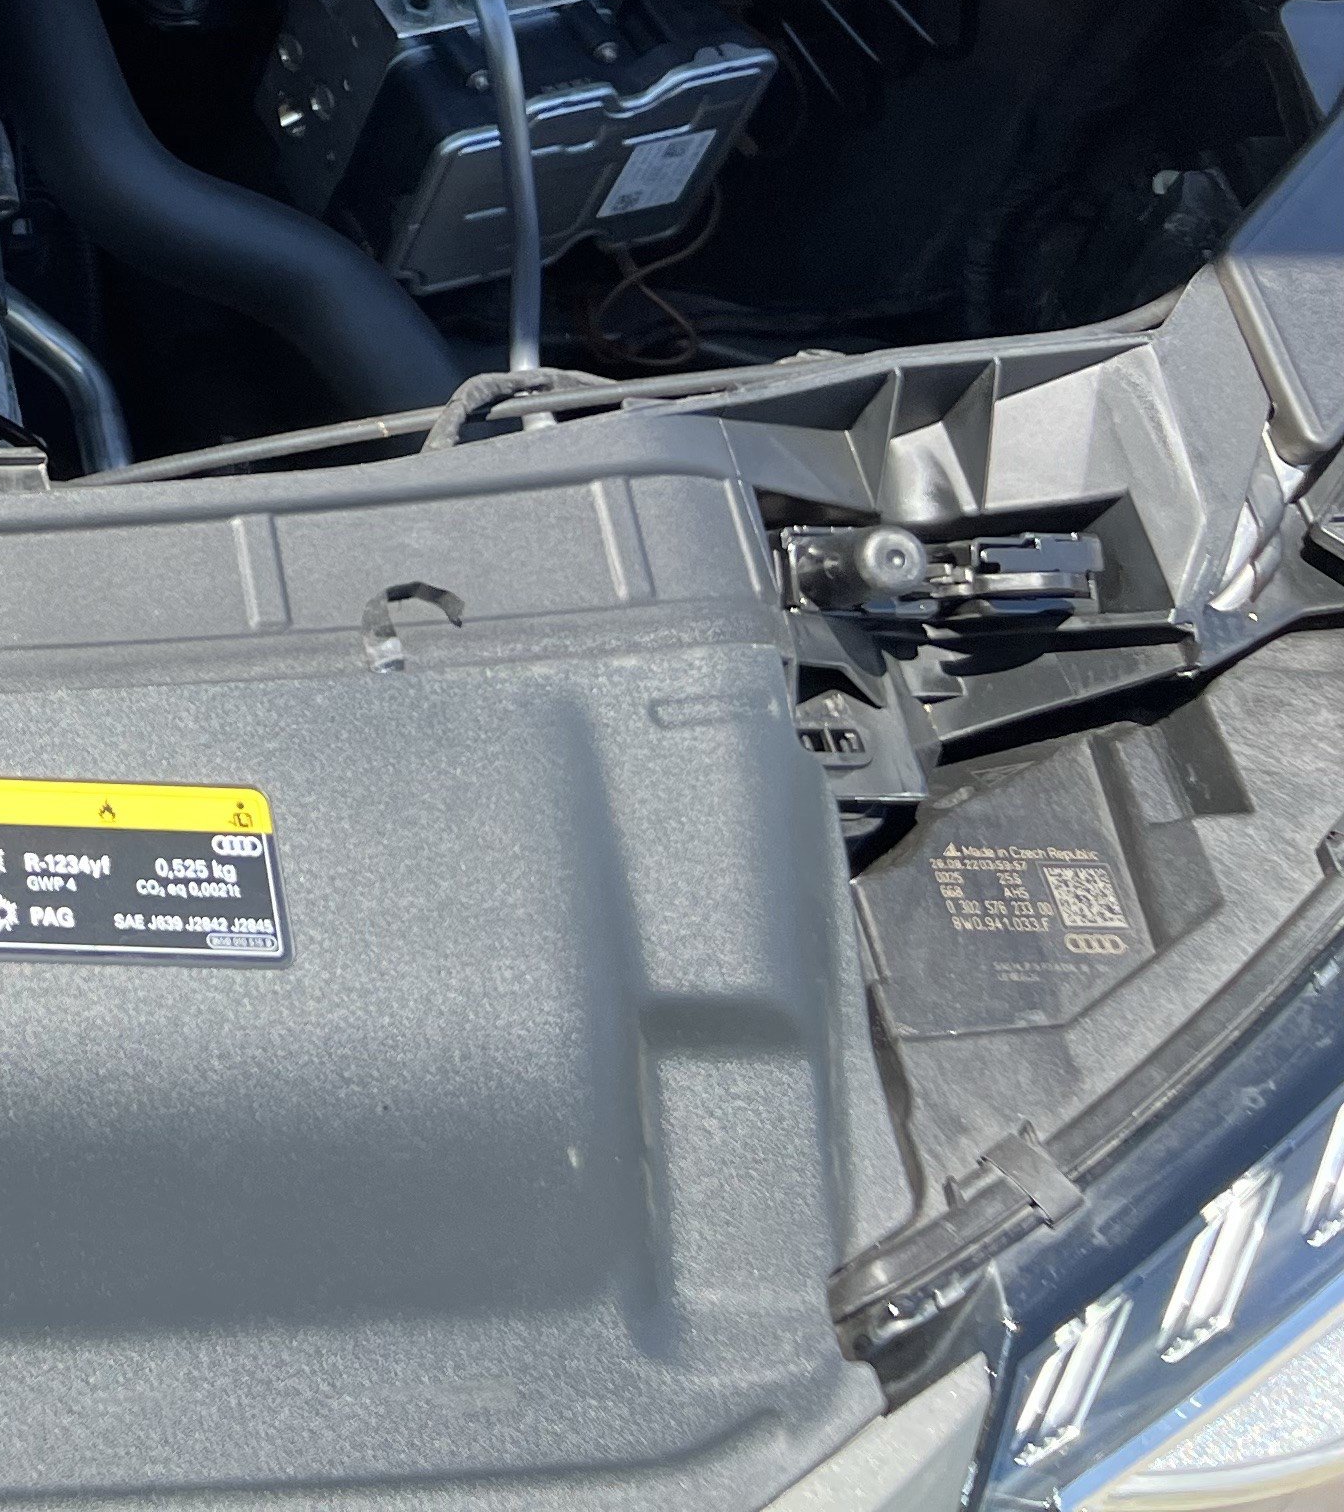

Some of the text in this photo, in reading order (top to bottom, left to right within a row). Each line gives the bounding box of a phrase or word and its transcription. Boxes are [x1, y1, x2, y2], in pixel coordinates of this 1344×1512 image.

[962, 844, 1099, 863] Made in Czech Republic
[23, 852, 111, 879] R-1234yf
[211, 860, 238, 883] kg
[27, 875, 65, 892] GWP
[29, 906, 75, 928] PAG
[113, 913, 146, 930] SAE
